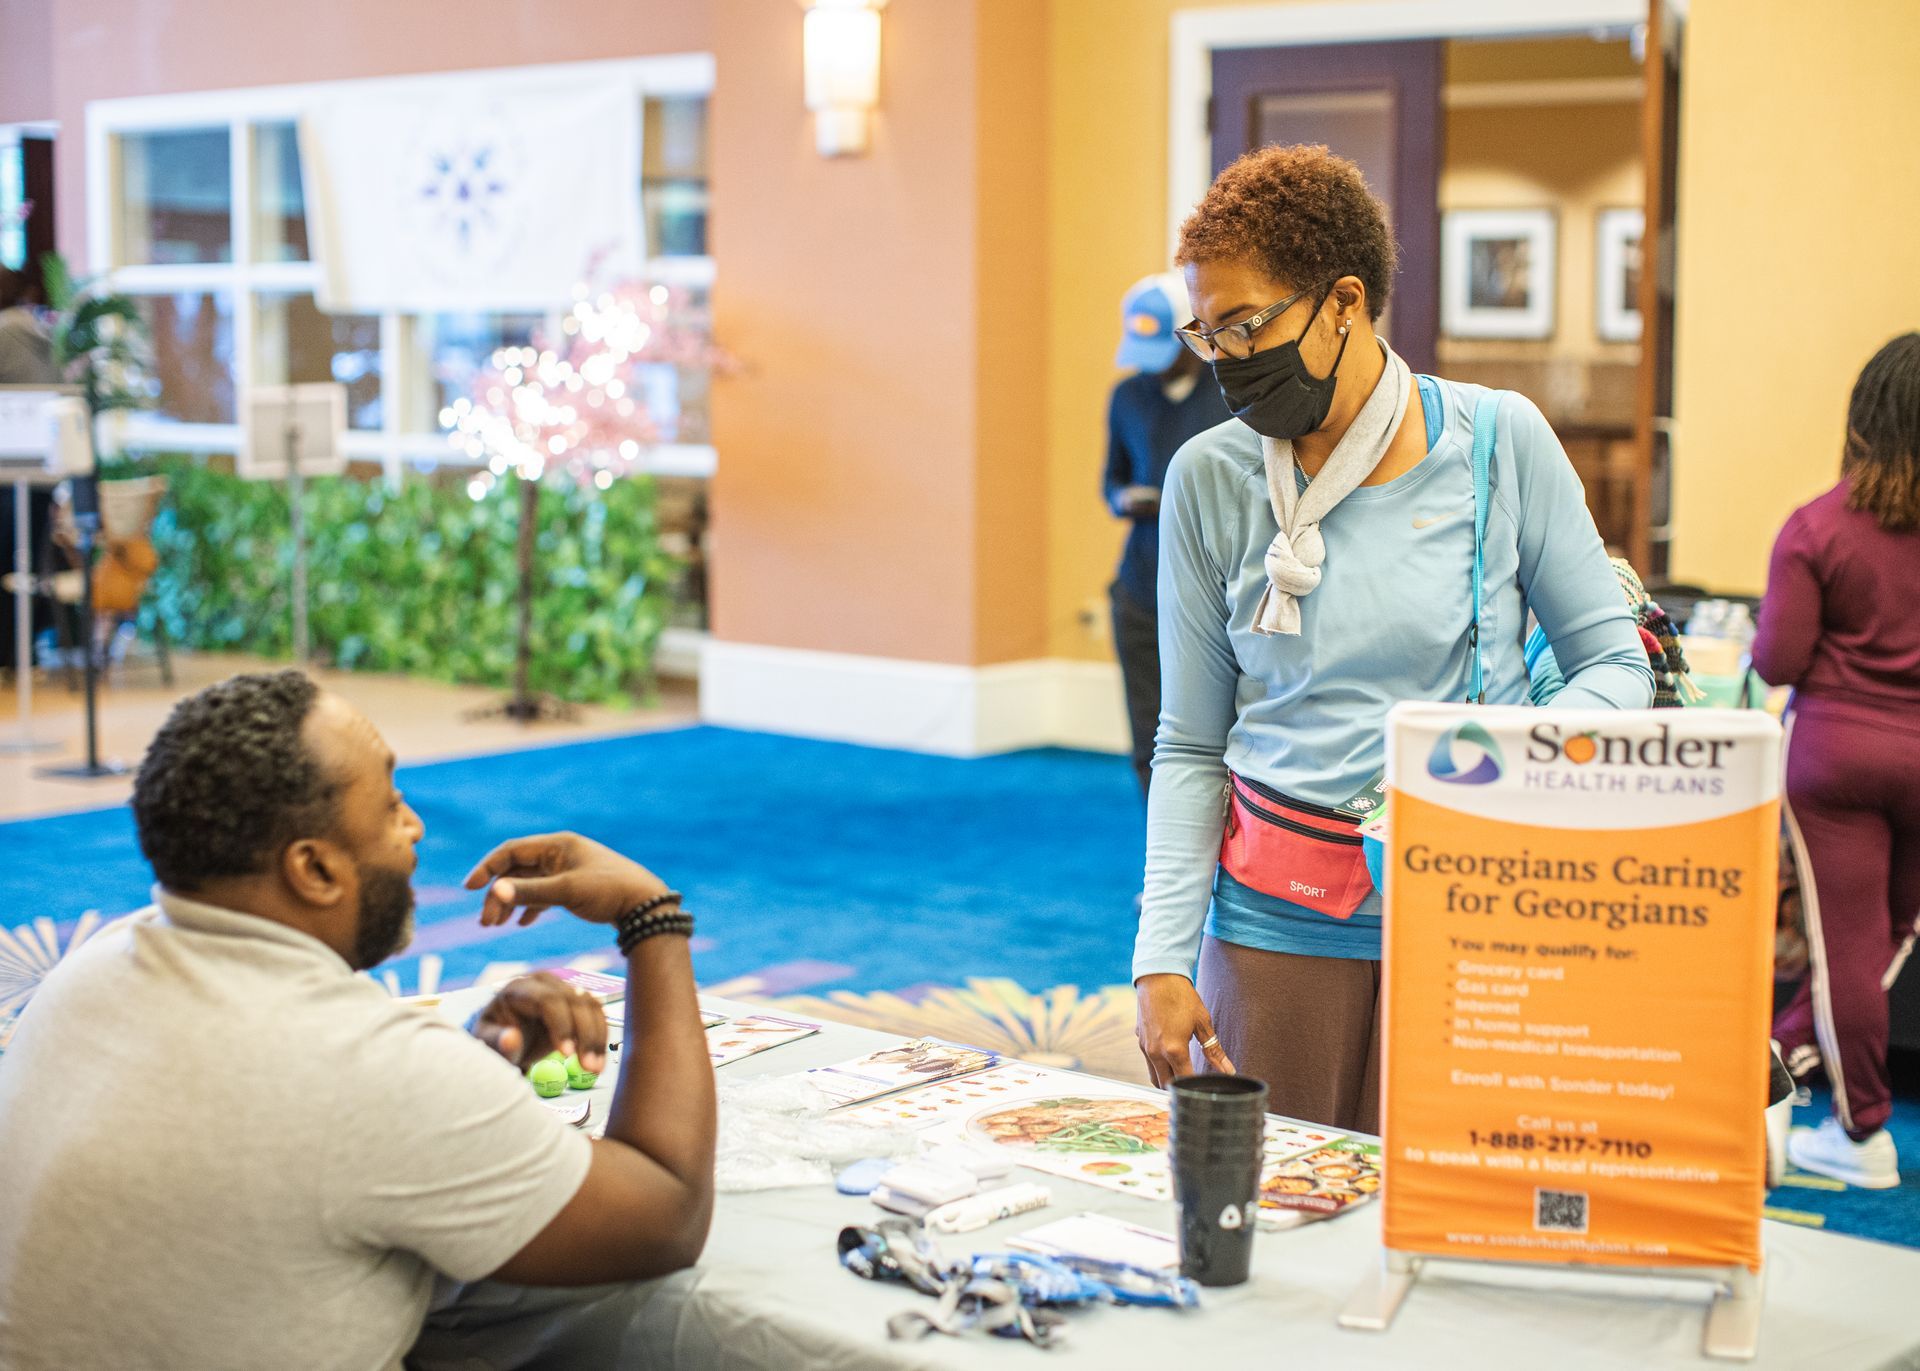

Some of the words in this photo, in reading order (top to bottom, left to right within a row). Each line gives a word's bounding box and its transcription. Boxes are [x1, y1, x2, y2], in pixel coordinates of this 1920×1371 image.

[1527, 722, 1734, 770] Sonder
[1525, 771, 1627, 793] HEALTH
[1637, 776, 1724, 795] PLANS
[1405, 845, 1597, 885] Georgians
[1613, 855, 1742, 897] Caring
[1290, 880, 1327, 898] SPORT
[1447, 883, 1498, 915] for
[1514, 889, 1708, 930] Georgians
[1449, 937, 1484, 953] You
[1491, 941, 1527, 956] may
[1537, 942, 1598, 960] qualify
[1457, 961, 1522, 980] Grocery
[1527, 965, 1564, 981] card
[1456, 980, 1487, 996] Gas
[1492, 983, 1528, 998] card
[1455, 999, 1519, 1016] Internet
[1471, 1018, 1520, 1034] home
[1526, 1022, 1589, 1040] support
[1452, 1035, 1557, 1055] Non-medical
[1562, 1043, 1681, 1063] transportation
[1452, 1070, 1500, 1086] Enroll
[1508, 1073, 1545, 1090] with
[1551, 1077, 1611, 1095] Sonder
[1619, 1081, 1674, 1100] today!
[1517, 1115, 1551, 1130] Call
[1556, 1119, 1574, 1132] us
[1580, 1120, 1597, 1134] at
[1470, 1131, 1651, 1159] 1-888-217-7110
[1406, 1147, 1424, 1162] to
[1429, 1150, 1480, 1169] speak
[1485, 1153, 1524, 1171] with
[1528, 1159, 1539, 1171] a
[1545, 1157, 1586, 1175] local
[1592, 1163, 1719, 1183] representative
